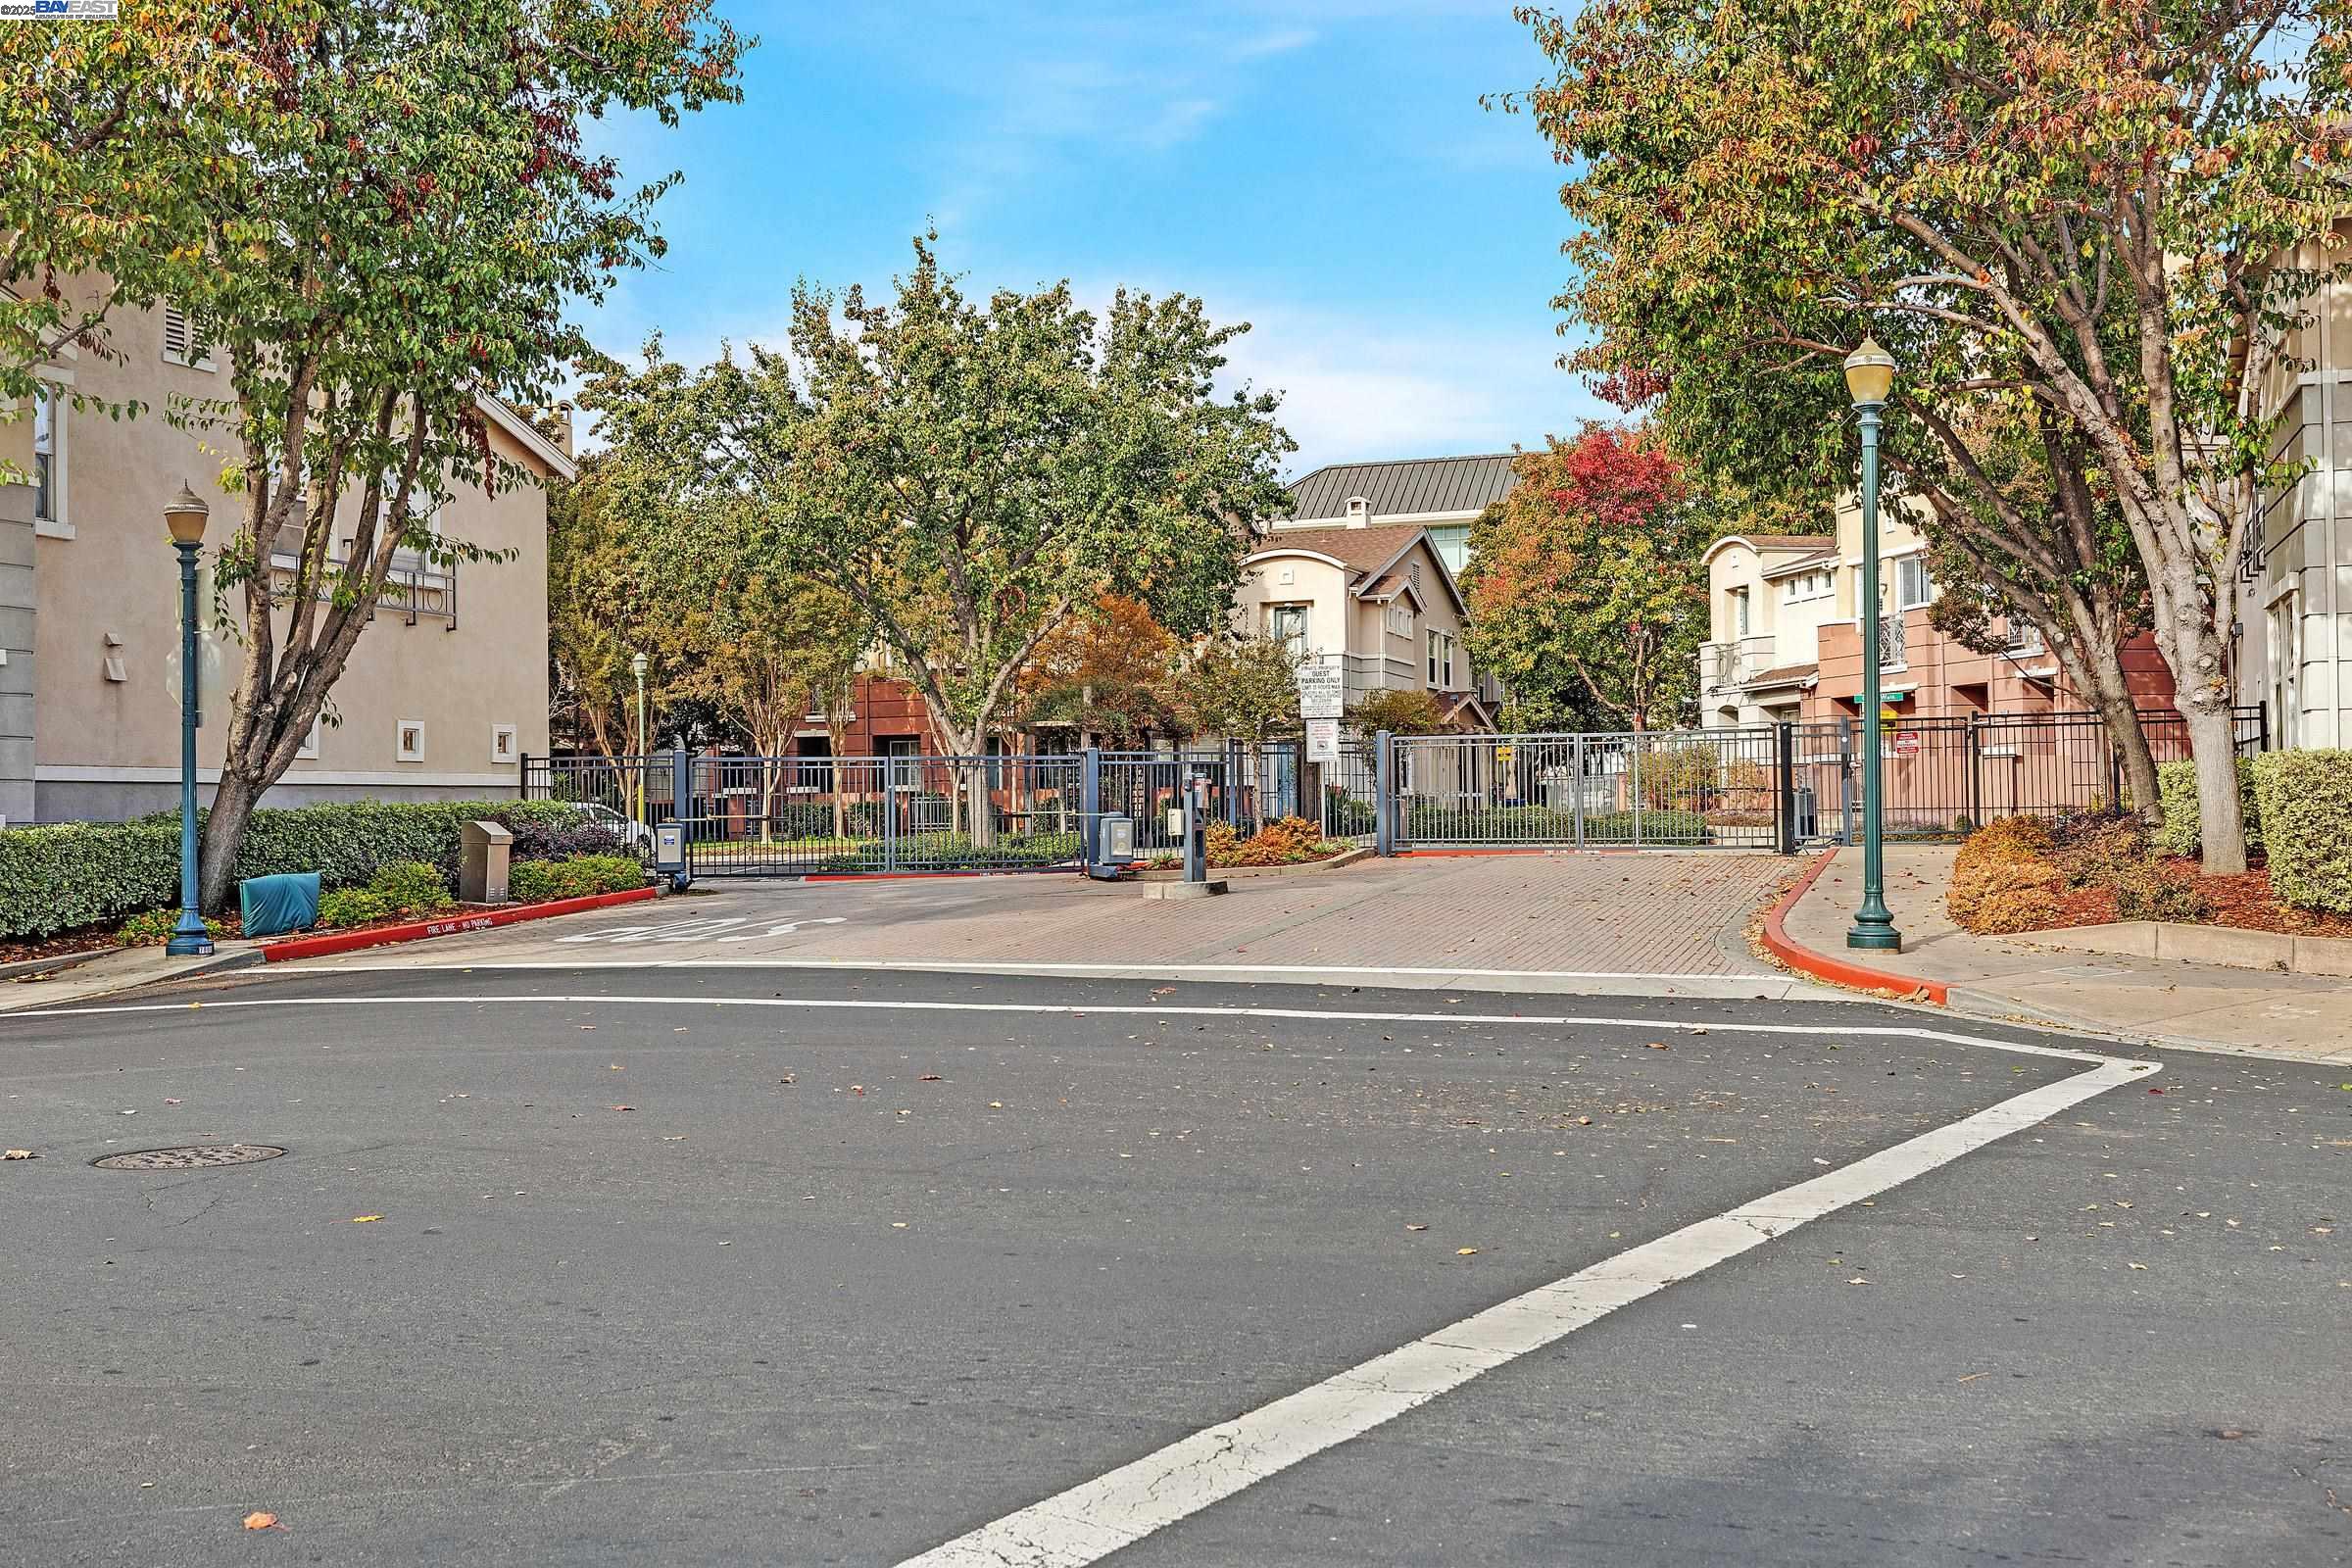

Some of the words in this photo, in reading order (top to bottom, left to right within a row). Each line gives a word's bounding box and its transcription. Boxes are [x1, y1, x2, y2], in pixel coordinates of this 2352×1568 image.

[426, 925, 440, 934] FIRE
[441, 922, 457, 933] LANE
[462, 920, 470, 929] NO
[470, 917, 493, 928] PARKING
